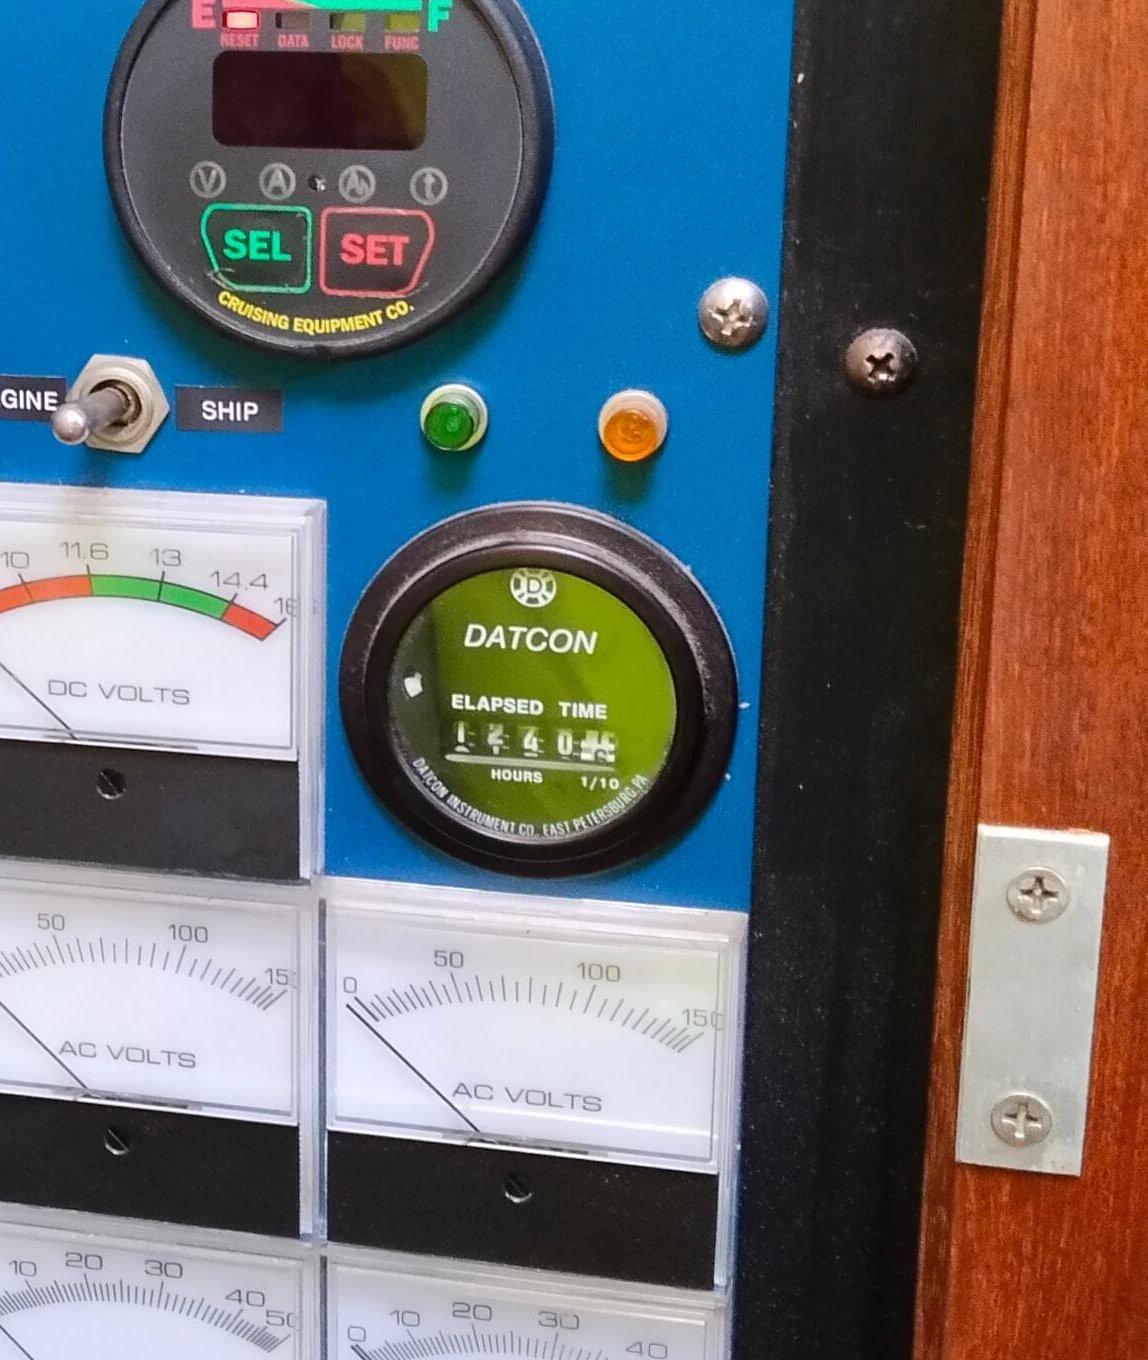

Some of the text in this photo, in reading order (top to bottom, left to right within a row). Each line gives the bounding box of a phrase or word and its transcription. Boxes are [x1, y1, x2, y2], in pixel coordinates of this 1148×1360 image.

[220, 33, 419, 50] RESET DATA LOCK FUNC
[223, 229, 410, 266] SEL SET
[218, 290, 415, 335] CRUISING EQUIPMENT CO.
[201, 399, 259, 421] SHIP
[58, 542, 109, 561] 11.6
[149, 548, 181, 567] 13
[209, 571, 268, 591] 14.4
[464, 623, 598, 654] DATCON
[48, 680, 190, 705] DC VOLTS
[452, 694, 607, 719] ELAPSED TIME
[491, 768, 543, 783] HOURS
[581, 776, 619, 791] 1/10
[413, 757, 516, 832] DATCON INSTRUMENT
[37, 913, 209, 943] 50 100
[434, 950, 621, 983] 50 100
[59, 1041, 196, 1069] AC VOLTS
[452, 1082, 603, 1113] AC VOLTS
[8, 1252, 265, 1308] 10 20 30 40
[390, 1310, 420, 1327] 10
[452, 1302, 492, 1321] 20
[538, 1310, 579, 1330] 30
[625, 1341, 668, 1360] 40
